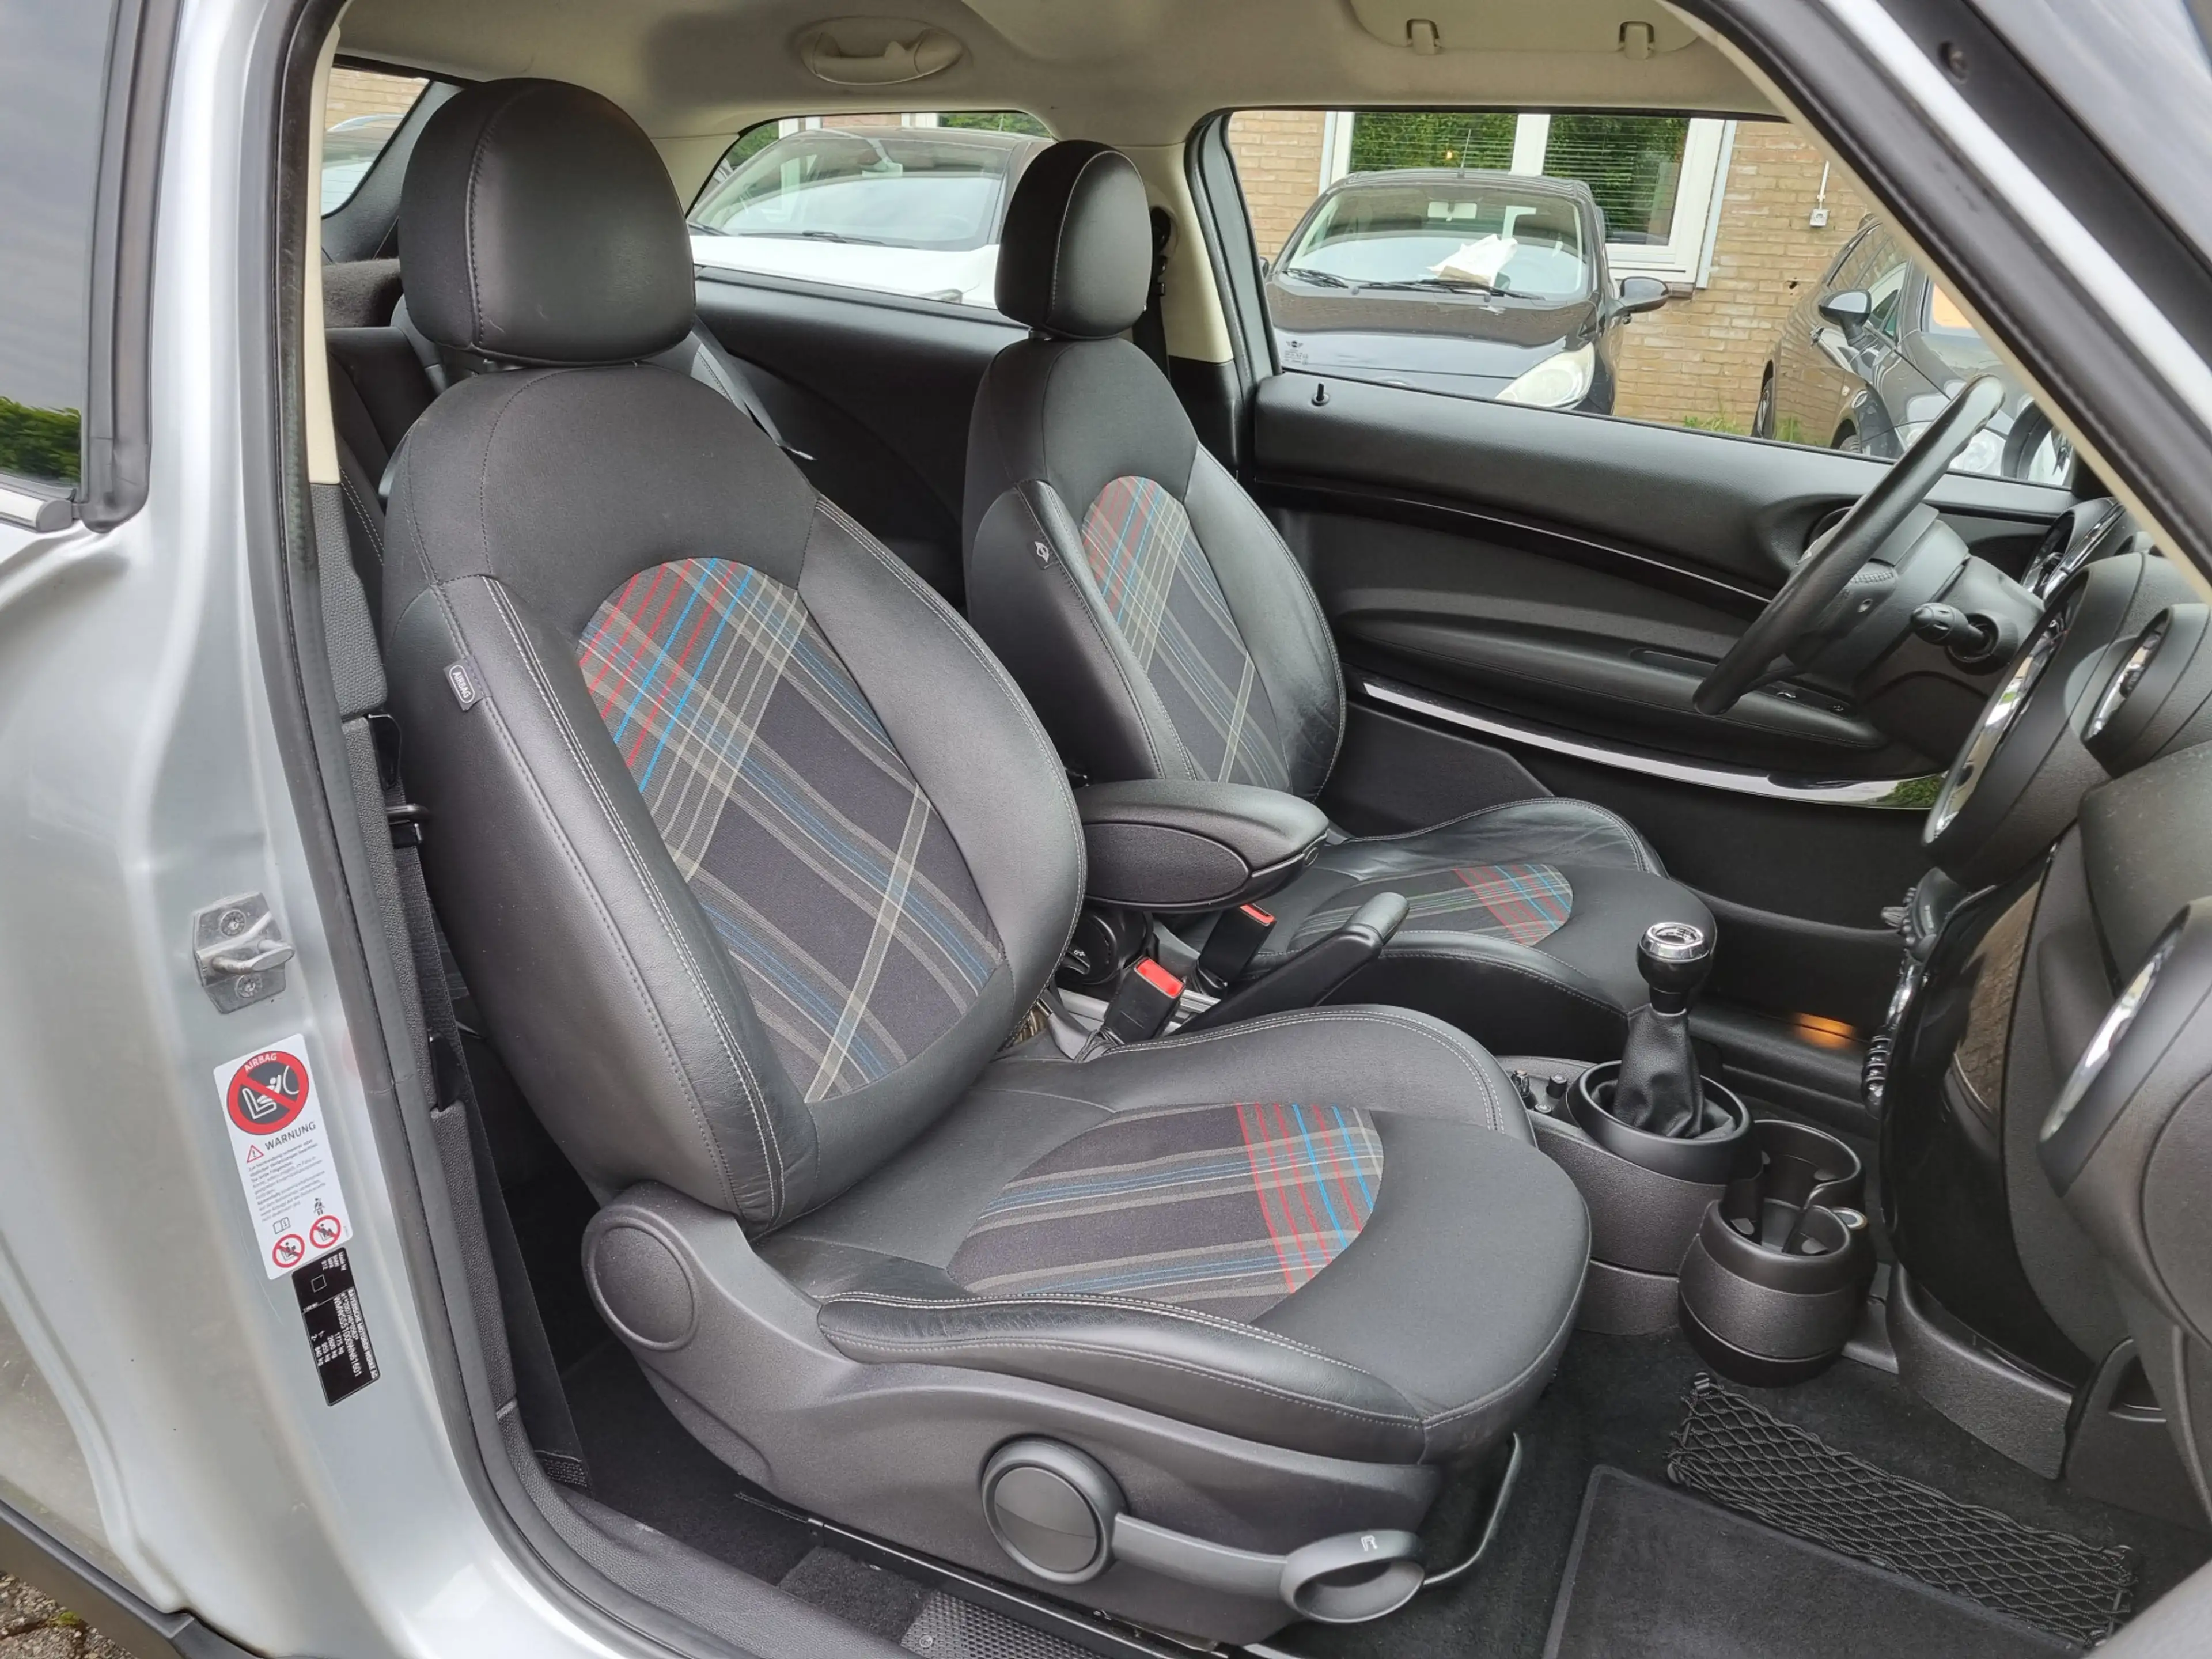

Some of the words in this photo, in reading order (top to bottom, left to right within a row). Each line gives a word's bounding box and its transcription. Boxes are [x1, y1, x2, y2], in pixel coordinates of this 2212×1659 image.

[452, 671, 471, 699] AIRBAG
[244, 1053, 277, 1073] AIRBAG
[264, 1121, 316, 1150] WARNUNG
